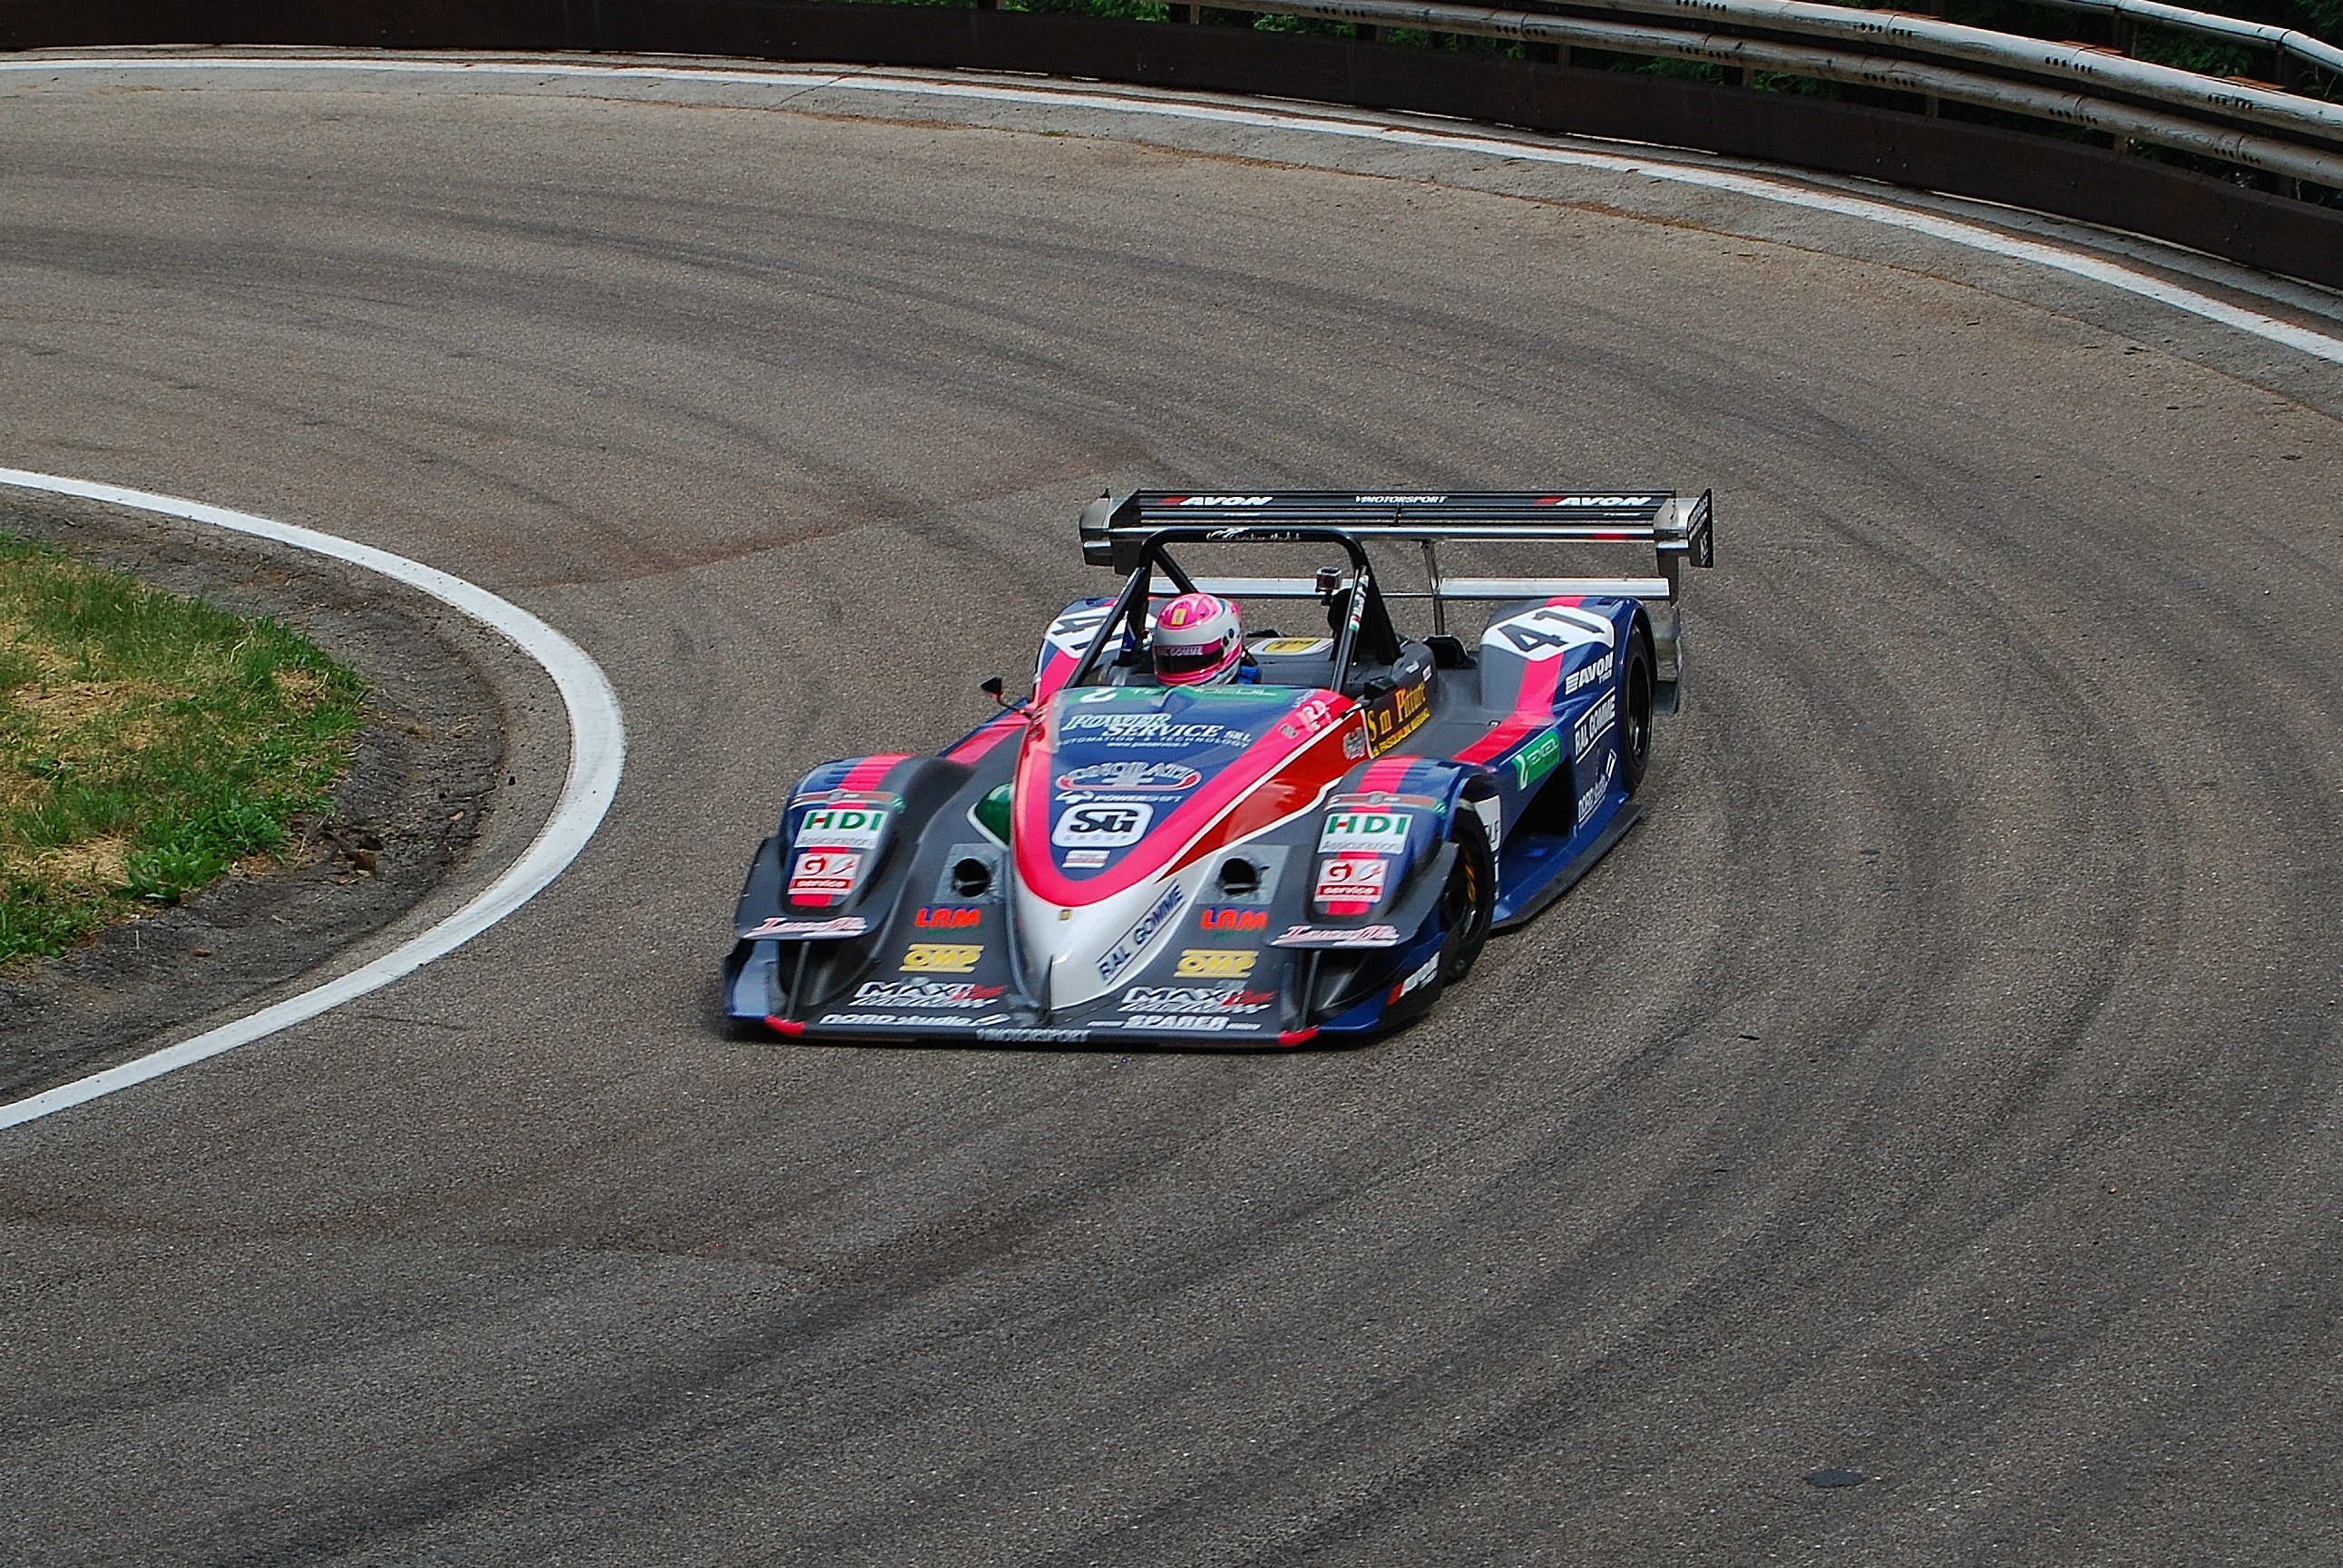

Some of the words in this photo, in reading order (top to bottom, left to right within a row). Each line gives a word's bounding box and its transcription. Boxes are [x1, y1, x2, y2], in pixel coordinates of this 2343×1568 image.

[1179, 496, 1273, 506] AVON
[1556, 496, 1652, 506] AVON
[1498, 609, 1606, 652] 41
[1578, 651, 1614, 687] AVON
[1061, 713, 1173, 732] POWER
[1102, 725, 1225, 738] SERVICE
[805, 812, 883, 831] HDI
[1326, 815, 1408, 835] HDI
[1133, 883, 1184, 946] GOMME
[903, 949, 981, 969] OMP
[1176, 955, 1257, 973] OMP
